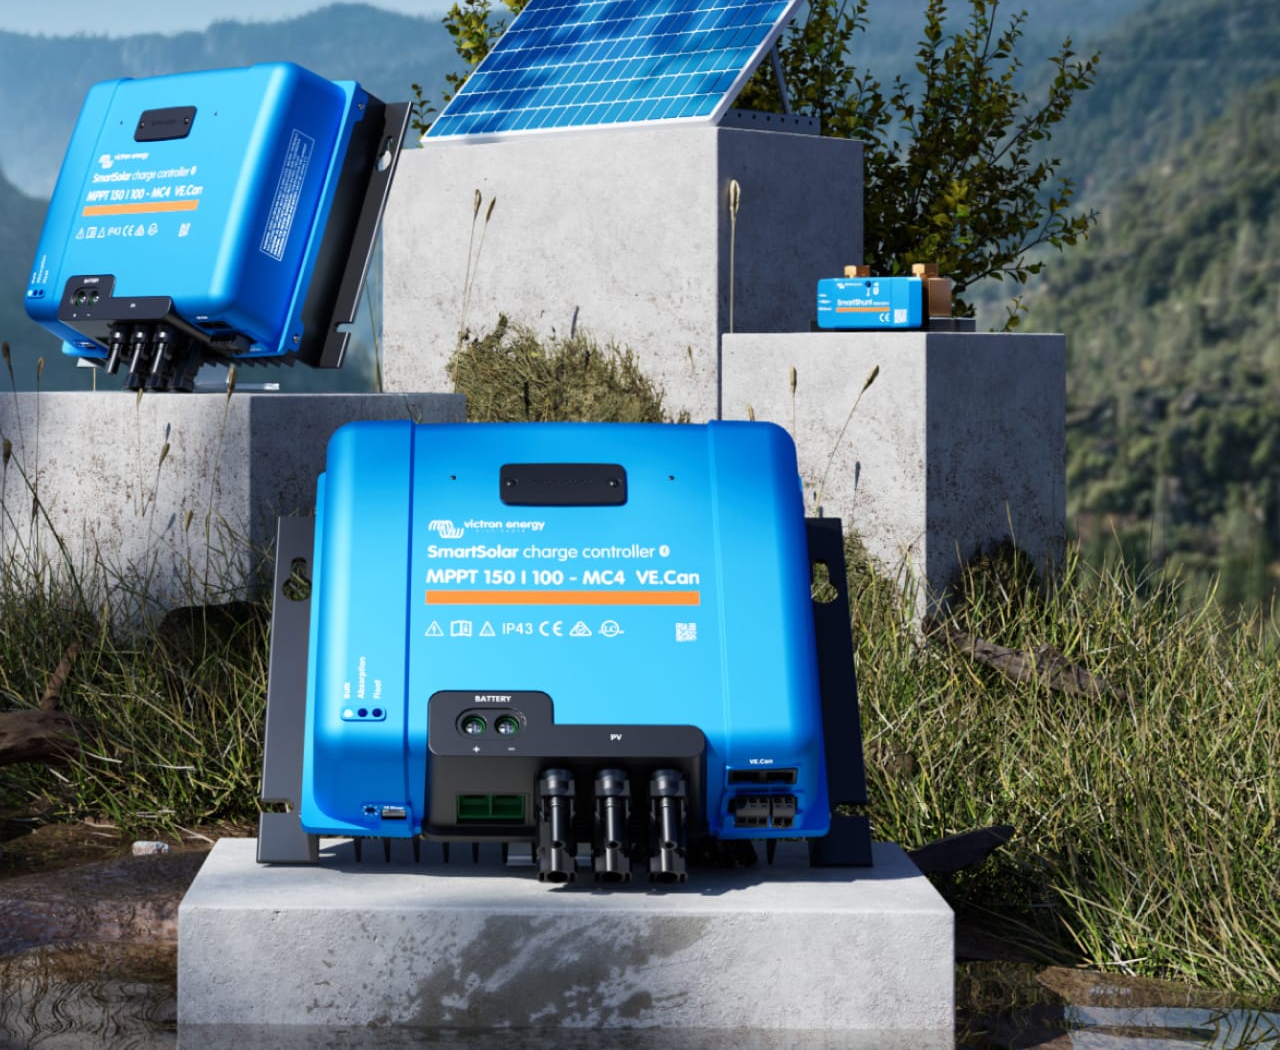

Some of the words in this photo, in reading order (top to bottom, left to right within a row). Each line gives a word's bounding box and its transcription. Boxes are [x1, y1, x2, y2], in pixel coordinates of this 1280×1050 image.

[132, 169, 156, 182] charge
[86, 190, 111, 202] MPPT
[130, 188, 145, 200] 100
[150, 186, 172, 199] MC4
[464, 519, 503, 529] victron
[506, 520, 545, 531] energy
[427, 544, 519, 559] SmartSolar
[523, 544, 578, 562] charge
[582, 543, 655, 559] controller
[425, 569, 479, 584] MPPT
[484, 569, 516, 585] 150
[532, 569, 564, 585] 100
[582, 569, 625, 585] MC4
[635, 569, 700, 585] VE.Can
[502, 622, 533, 635] IP43
[474, 695, 512, 703] BATTERY
[610, 733, 623, 741] PV
